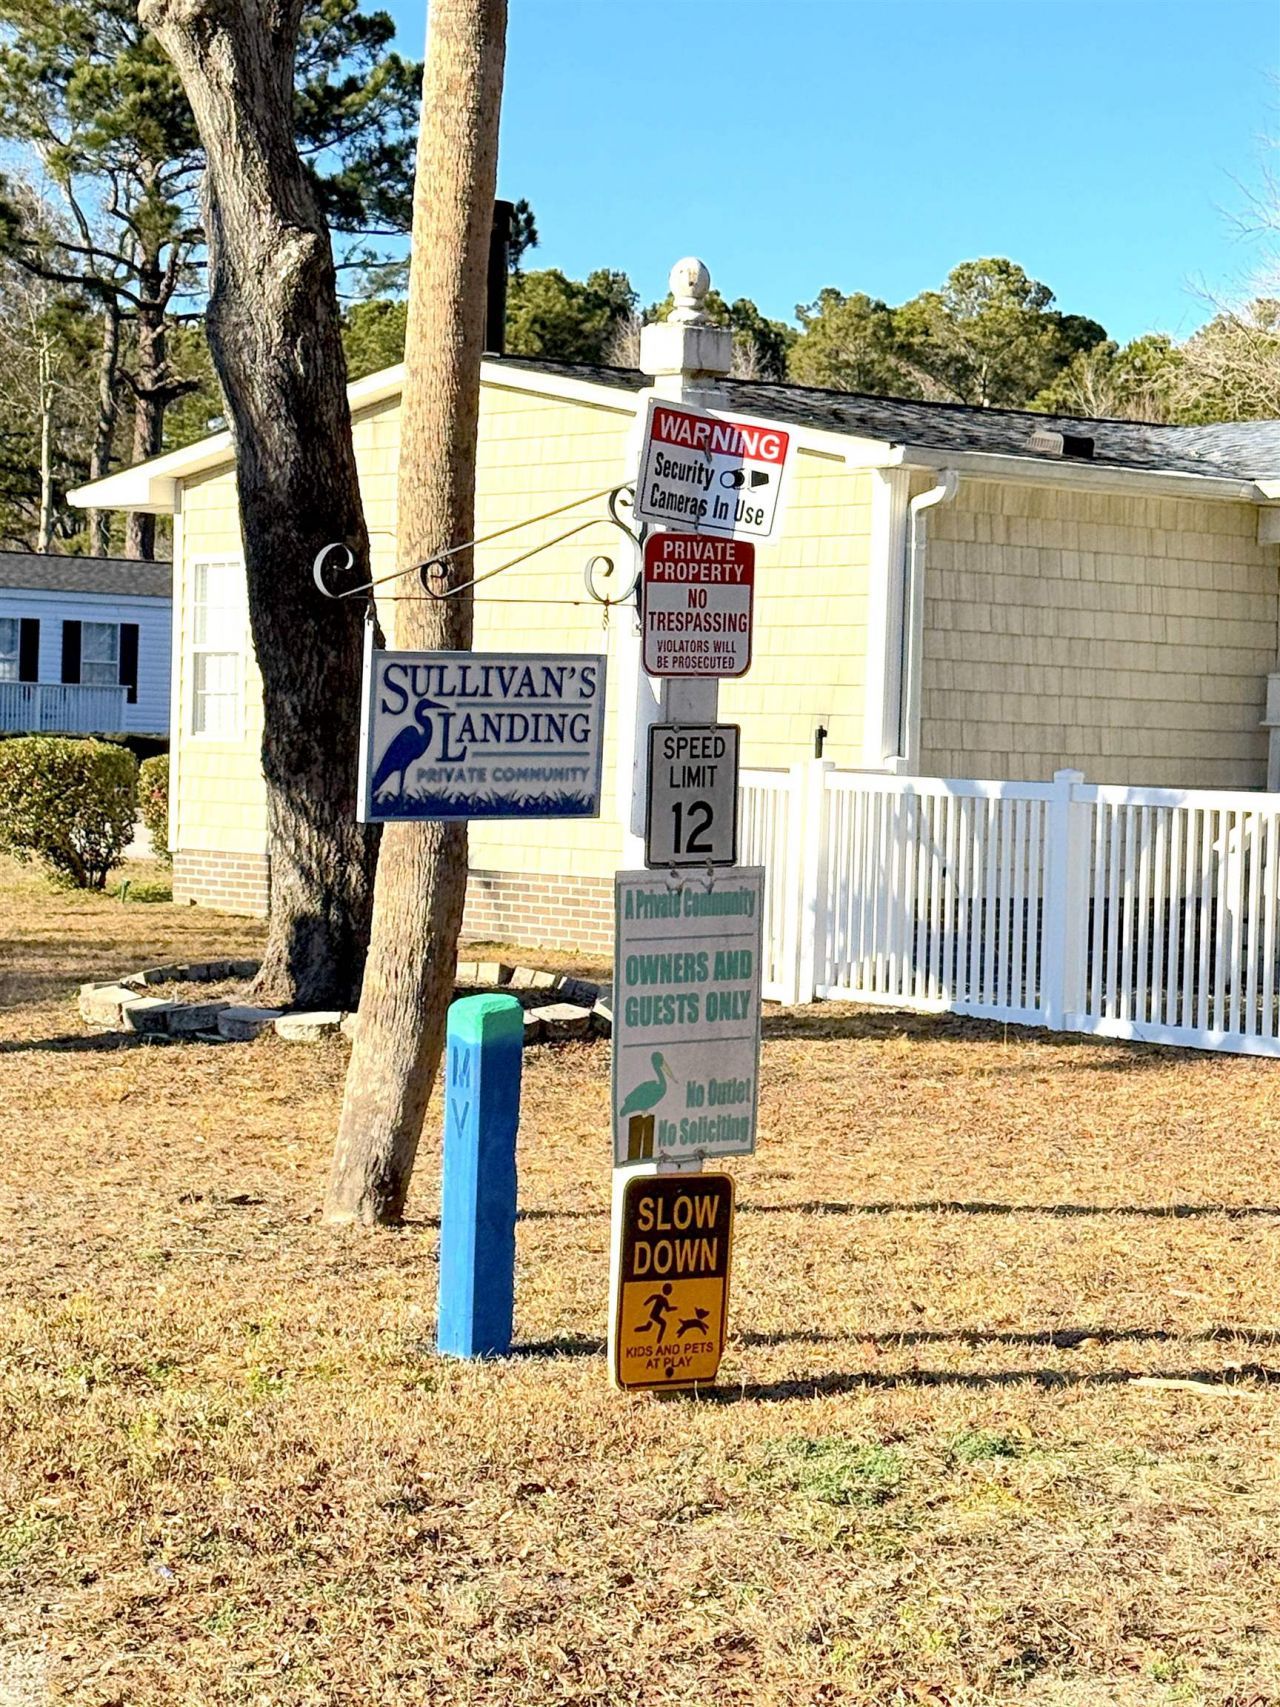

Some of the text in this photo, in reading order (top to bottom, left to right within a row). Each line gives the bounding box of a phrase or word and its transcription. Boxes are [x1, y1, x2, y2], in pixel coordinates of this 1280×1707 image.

[660, 414, 781, 460] WARNING
[654, 451, 715, 492] Security
[650, 482, 764, 526] Cameras In Use
[663, 541, 736, 561] PRIVATE
[653, 562, 744, 582] PROPERTY
[688, 588, 707, 609] NO
[648, 611, 748, 633] TRESPASSING
[657, 639, 737, 654] VIOLATORS WILL
[656, 655, 735, 670] BE PROSECUTED
[381, 663, 596, 715] SULLIVAN'S
[435, 712, 592, 763] LANDING
[663, 736, 726, 759] SPEED
[416, 766, 590, 783] PRIVATE COMMUNITY
[669, 766, 718, 788] LIMIT
[672, 800, 714, 854] 12
[625, 886, 756, 919] A Private Community
[625, 950, 753, 986] OWNERS AND
[625, 989, 751, 1027] GUESTS ONLY
[686, 1078, 750, 1107] No Outlet
[658, 1113, 750, 1147] No Soliciting
[637, 1195, 719, 1231] SLOW
[633, 1238, 717, 1274] DOWN
[626, 1341, 714, 1358] KIDS AND PETS
[646, 1355, 693, 1369] AT PLAY
